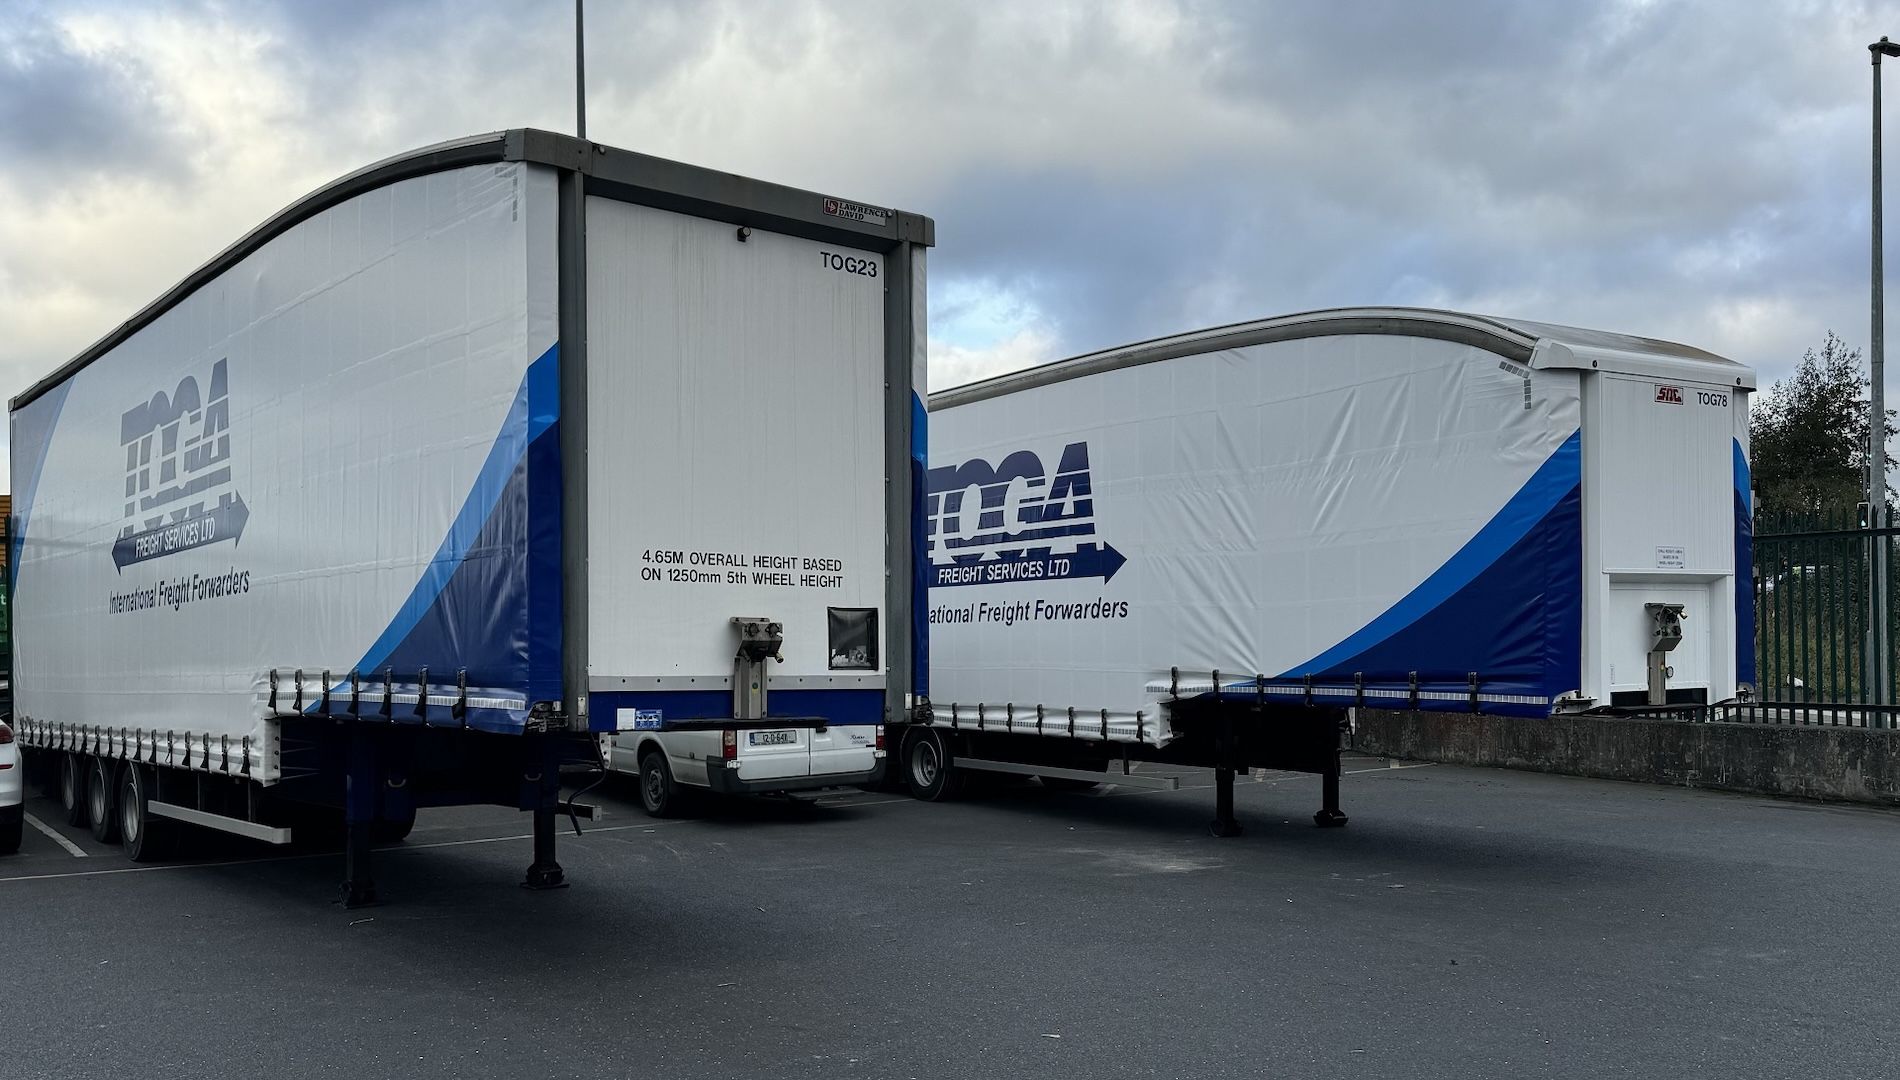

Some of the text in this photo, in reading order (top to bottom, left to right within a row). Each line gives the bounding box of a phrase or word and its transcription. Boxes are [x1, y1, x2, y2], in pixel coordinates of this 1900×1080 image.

[838, 209, 865, 220] DAVID
[840, 202, 886, 218] LAWRENCE
[820, 251, 877, 278] TOG23
[1697, 392, 1728, 407] TOG78
[135, 517, 216, 558] FREIGHT SERVICES LTD
[642, 550, 842, 572] 4.65M OVERALL HEIGHT BASED
[938, 558, 1070, 584] FREIGHT SERVICES LTD
[641, 567, 843, 588] ON 1250mm 5th WHEEL HEIGHT
[109, 565, 250, 615] International Freight Forwarders
[928, 597, 1129, 626] ational Freight Forwarders
